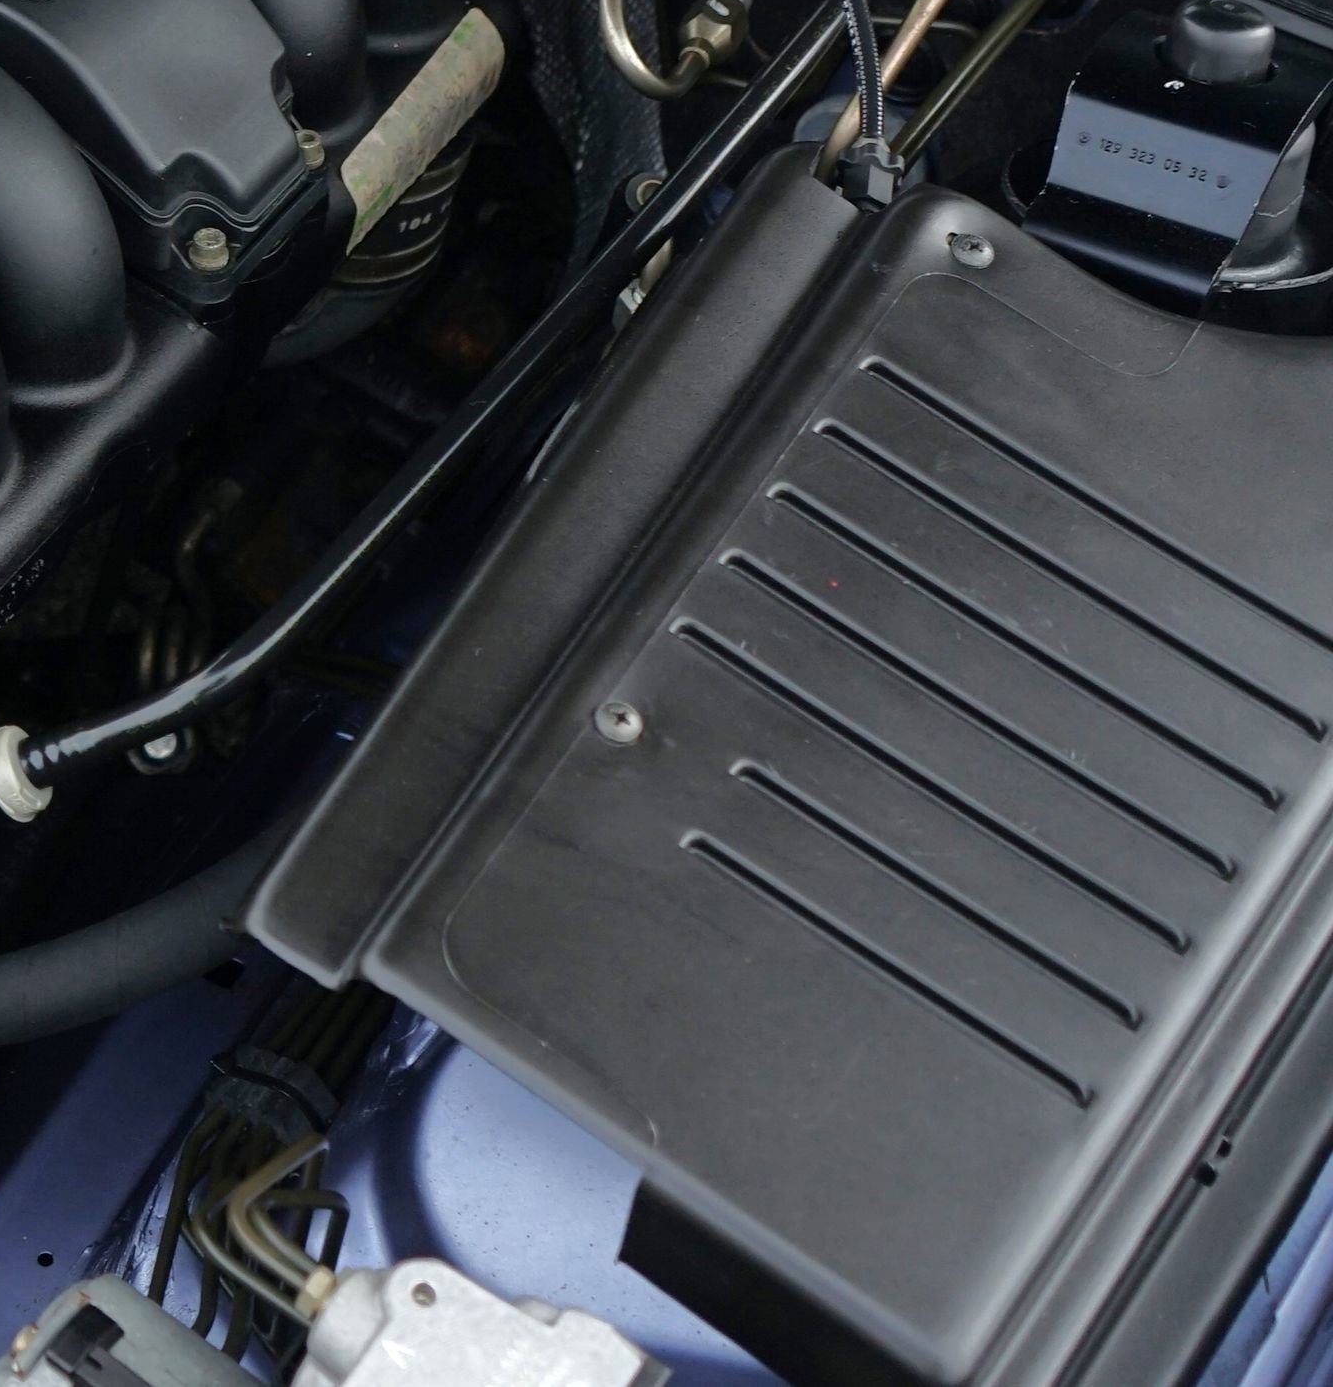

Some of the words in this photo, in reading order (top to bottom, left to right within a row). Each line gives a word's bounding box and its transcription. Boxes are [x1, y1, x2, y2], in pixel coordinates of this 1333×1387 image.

[1100, 138, 1122, 154] 129
[1129, 148, 1156, 165] 323
[1163, 158, 1181, 173] 05
[1188, 166, 1208, 182] 32
